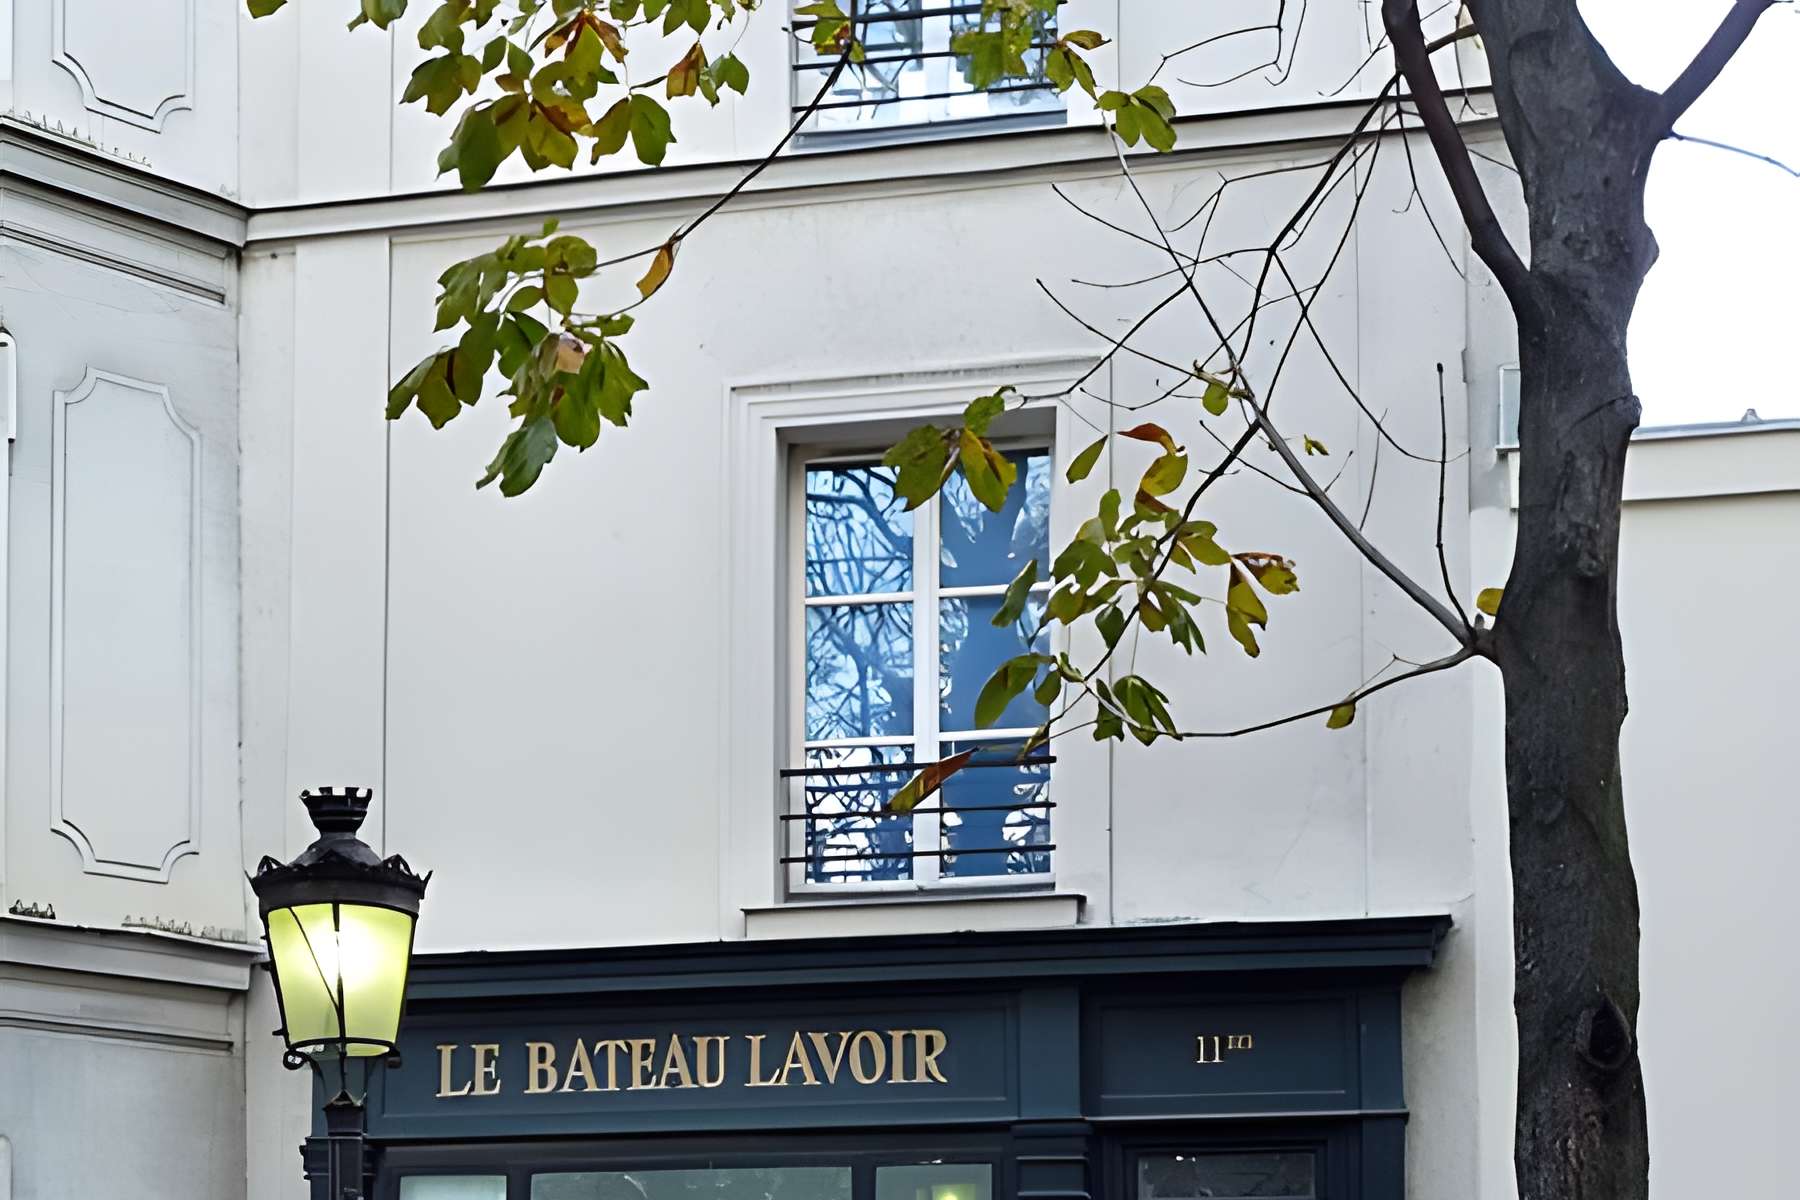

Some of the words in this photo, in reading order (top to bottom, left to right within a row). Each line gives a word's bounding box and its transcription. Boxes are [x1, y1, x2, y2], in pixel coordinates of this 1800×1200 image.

[435, 1043, 501, 1098] LE
[523, 1033, 731, 1094] BATEAU
[743, 1029, 948, 1087] LAVOIR
